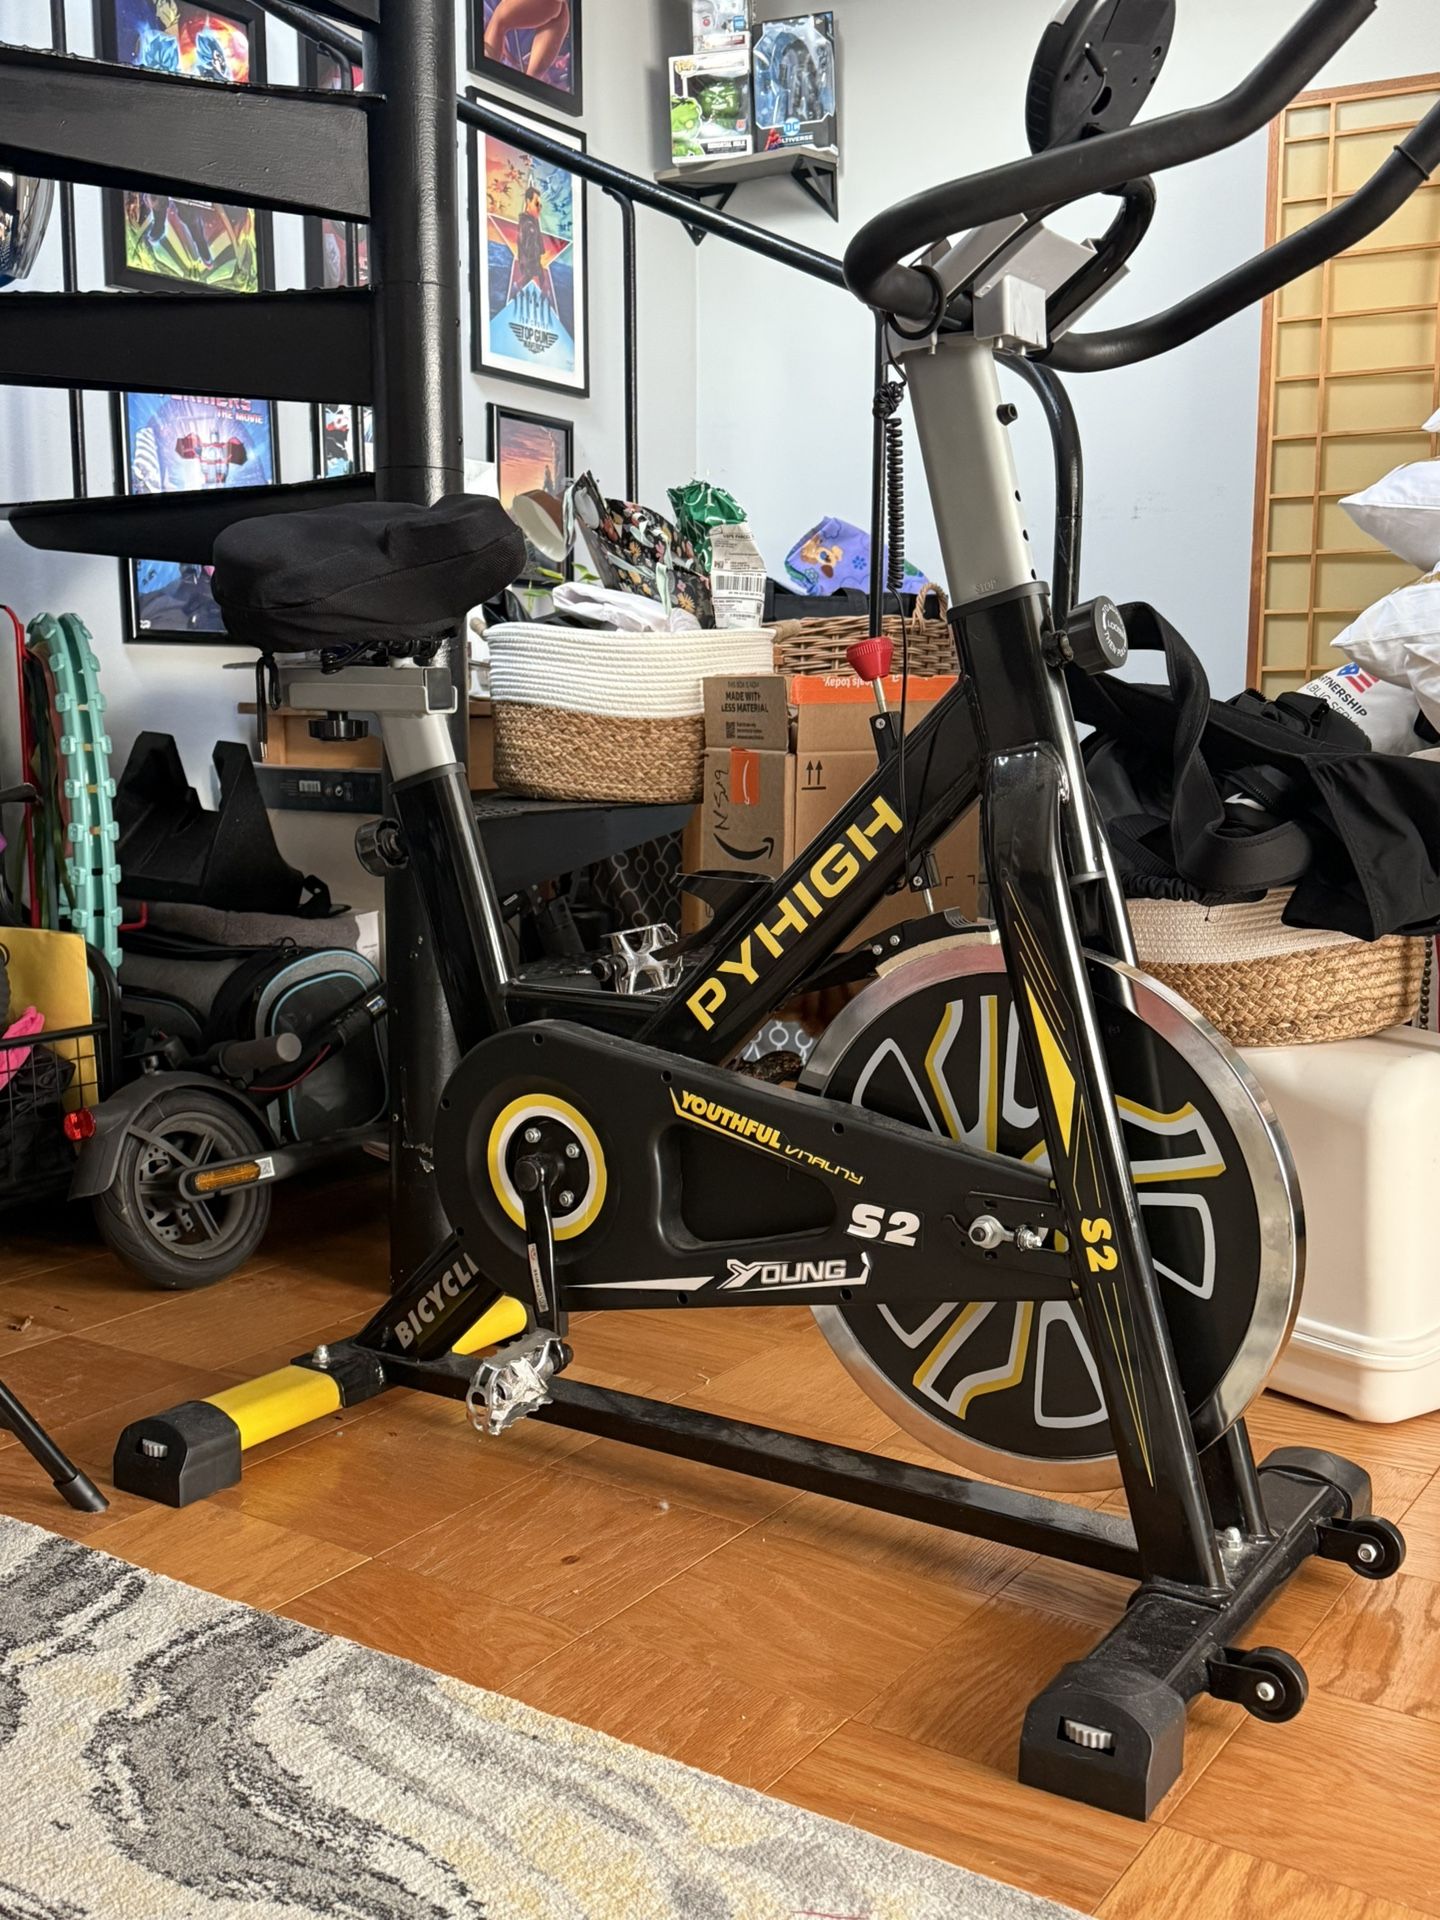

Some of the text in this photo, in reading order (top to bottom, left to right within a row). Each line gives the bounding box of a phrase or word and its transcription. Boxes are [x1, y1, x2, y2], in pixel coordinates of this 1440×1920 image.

[784, 122, 800, 134] DC
[780, 134, 813, 144] LTIVERSE
[521, 325, 549, 345] TOP GUN
[217, 407, 263, 425] THE MOVIE
[823, 676, 851, 688] today.
[725, 692, 744, 701] MADE
[721, 703, 768, 713] LESS MATERIAL
[686, 795, 904, 1032] PYHIGH
[681, 1089, 864, 1186] YOUTHFUL VITALITY
[846, 1203, 921, 1247] S2
[1080, 1217, 1119, 1273] S2
[716, 1257, 848, 1290] YOUNG
